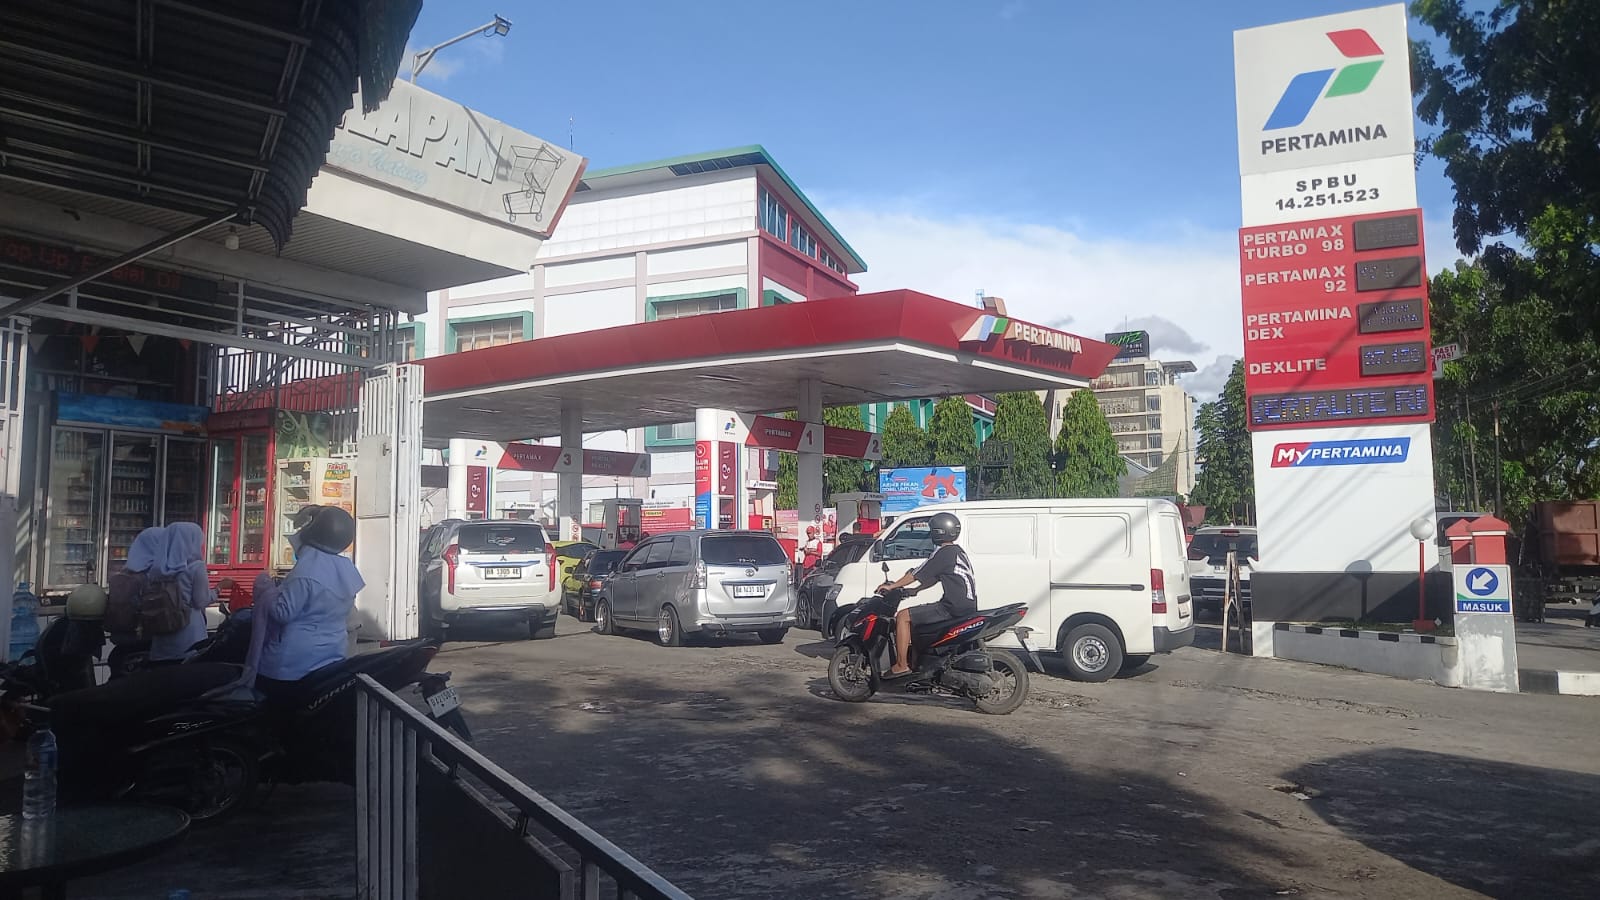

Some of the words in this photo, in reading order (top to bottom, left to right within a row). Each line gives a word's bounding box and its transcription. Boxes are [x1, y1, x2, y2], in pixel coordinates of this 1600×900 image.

[335, 96, 503, 184] LAPAN
[1261, 124, 1388, 155] PERTAMINA
[1296, 174, 1357, 192] SPBU
[1275, 187, 1380, 211] 14.251.523
[1243, 224, 1343, 247] PERTAMAX
[1245, 243, 1307, 261] TURBO
[1321, 239, 1345, 254] 98
[1245, 265, 1346, 287] PERTAMAX
[1324, 280, 1347, 293] 92
[1247, 306, 1352, 327] PERTAMINA
[1014, 321, 1082, 355] PERTAMINA
[1248, 327, 1284, 341] DEX
[1434, 344, 1457, 355] PASTI
[1249, 358, 1327, 376] DEXLITE
[806, 430, 813, 445] 1
[872, 439, 879, 453] 2
[563, 454, 572, 466] 3
[1462, 602, 1503, 612] MASUK
